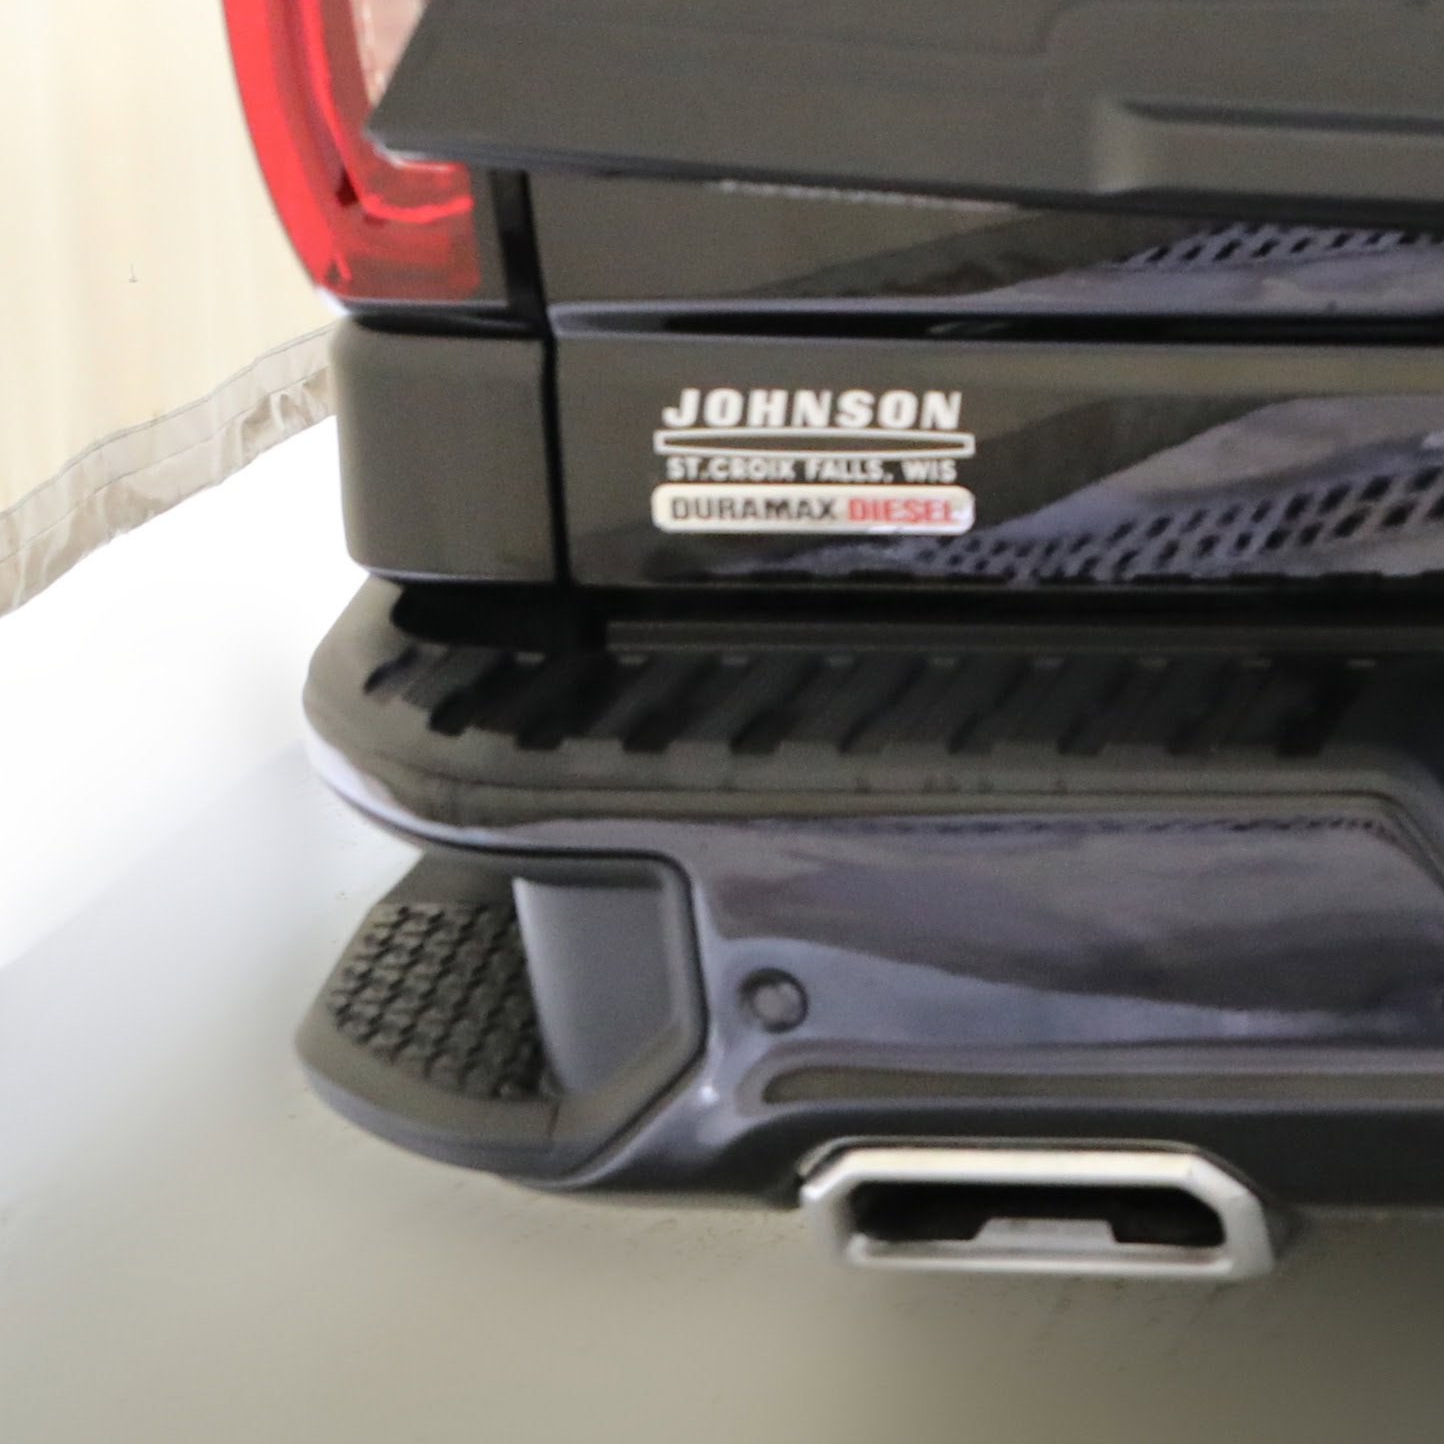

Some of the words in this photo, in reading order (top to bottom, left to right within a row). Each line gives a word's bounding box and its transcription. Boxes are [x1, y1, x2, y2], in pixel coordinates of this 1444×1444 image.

[661, 387, 963, 430] JOHNSON
[901, 460, 958, 483] WIS
[671, 497, 837, 523] DURAMAX
[847, 499, 955, 525] DIESEL
